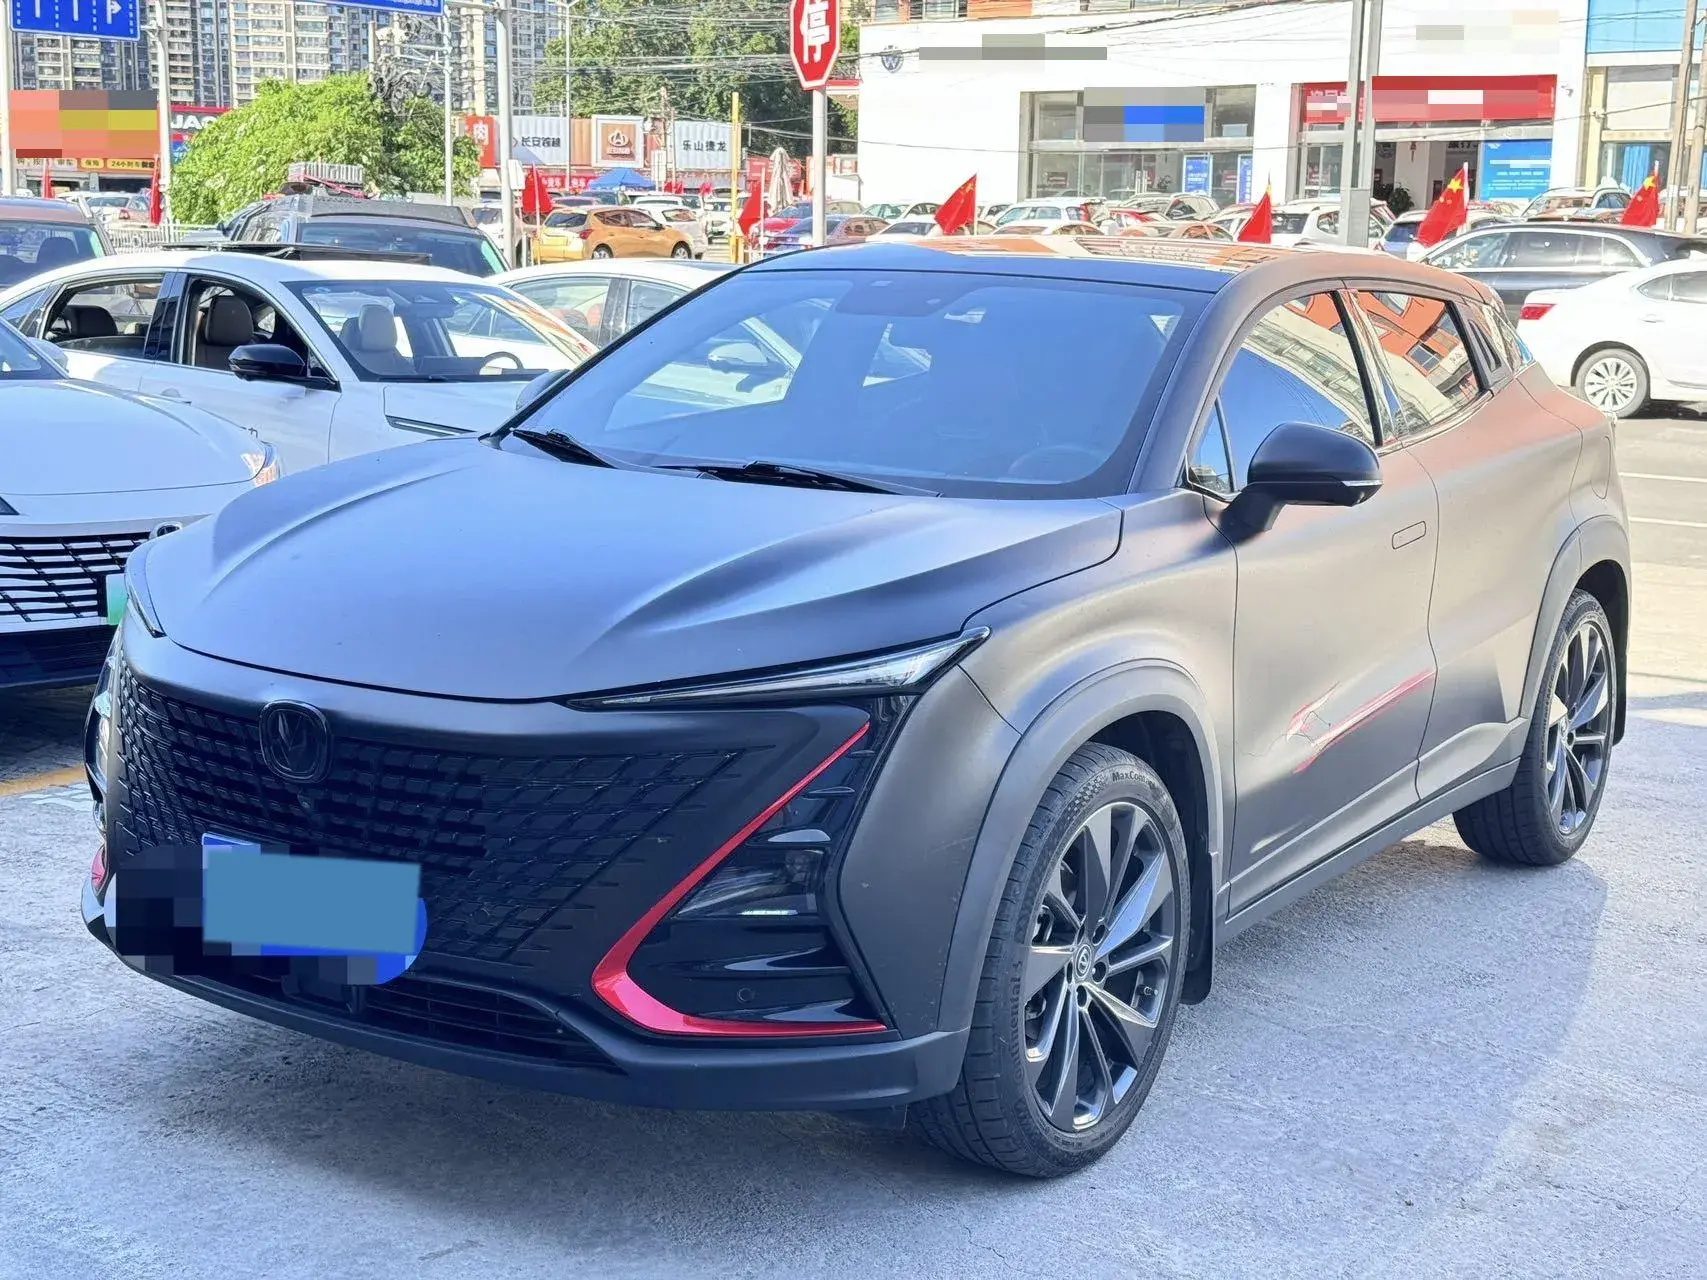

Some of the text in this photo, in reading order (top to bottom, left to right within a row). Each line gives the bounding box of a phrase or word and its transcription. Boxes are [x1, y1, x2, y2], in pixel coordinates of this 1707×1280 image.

[799, 0, 830, 64] 停
[682, 139, 728, 153] 乐山捷龙
